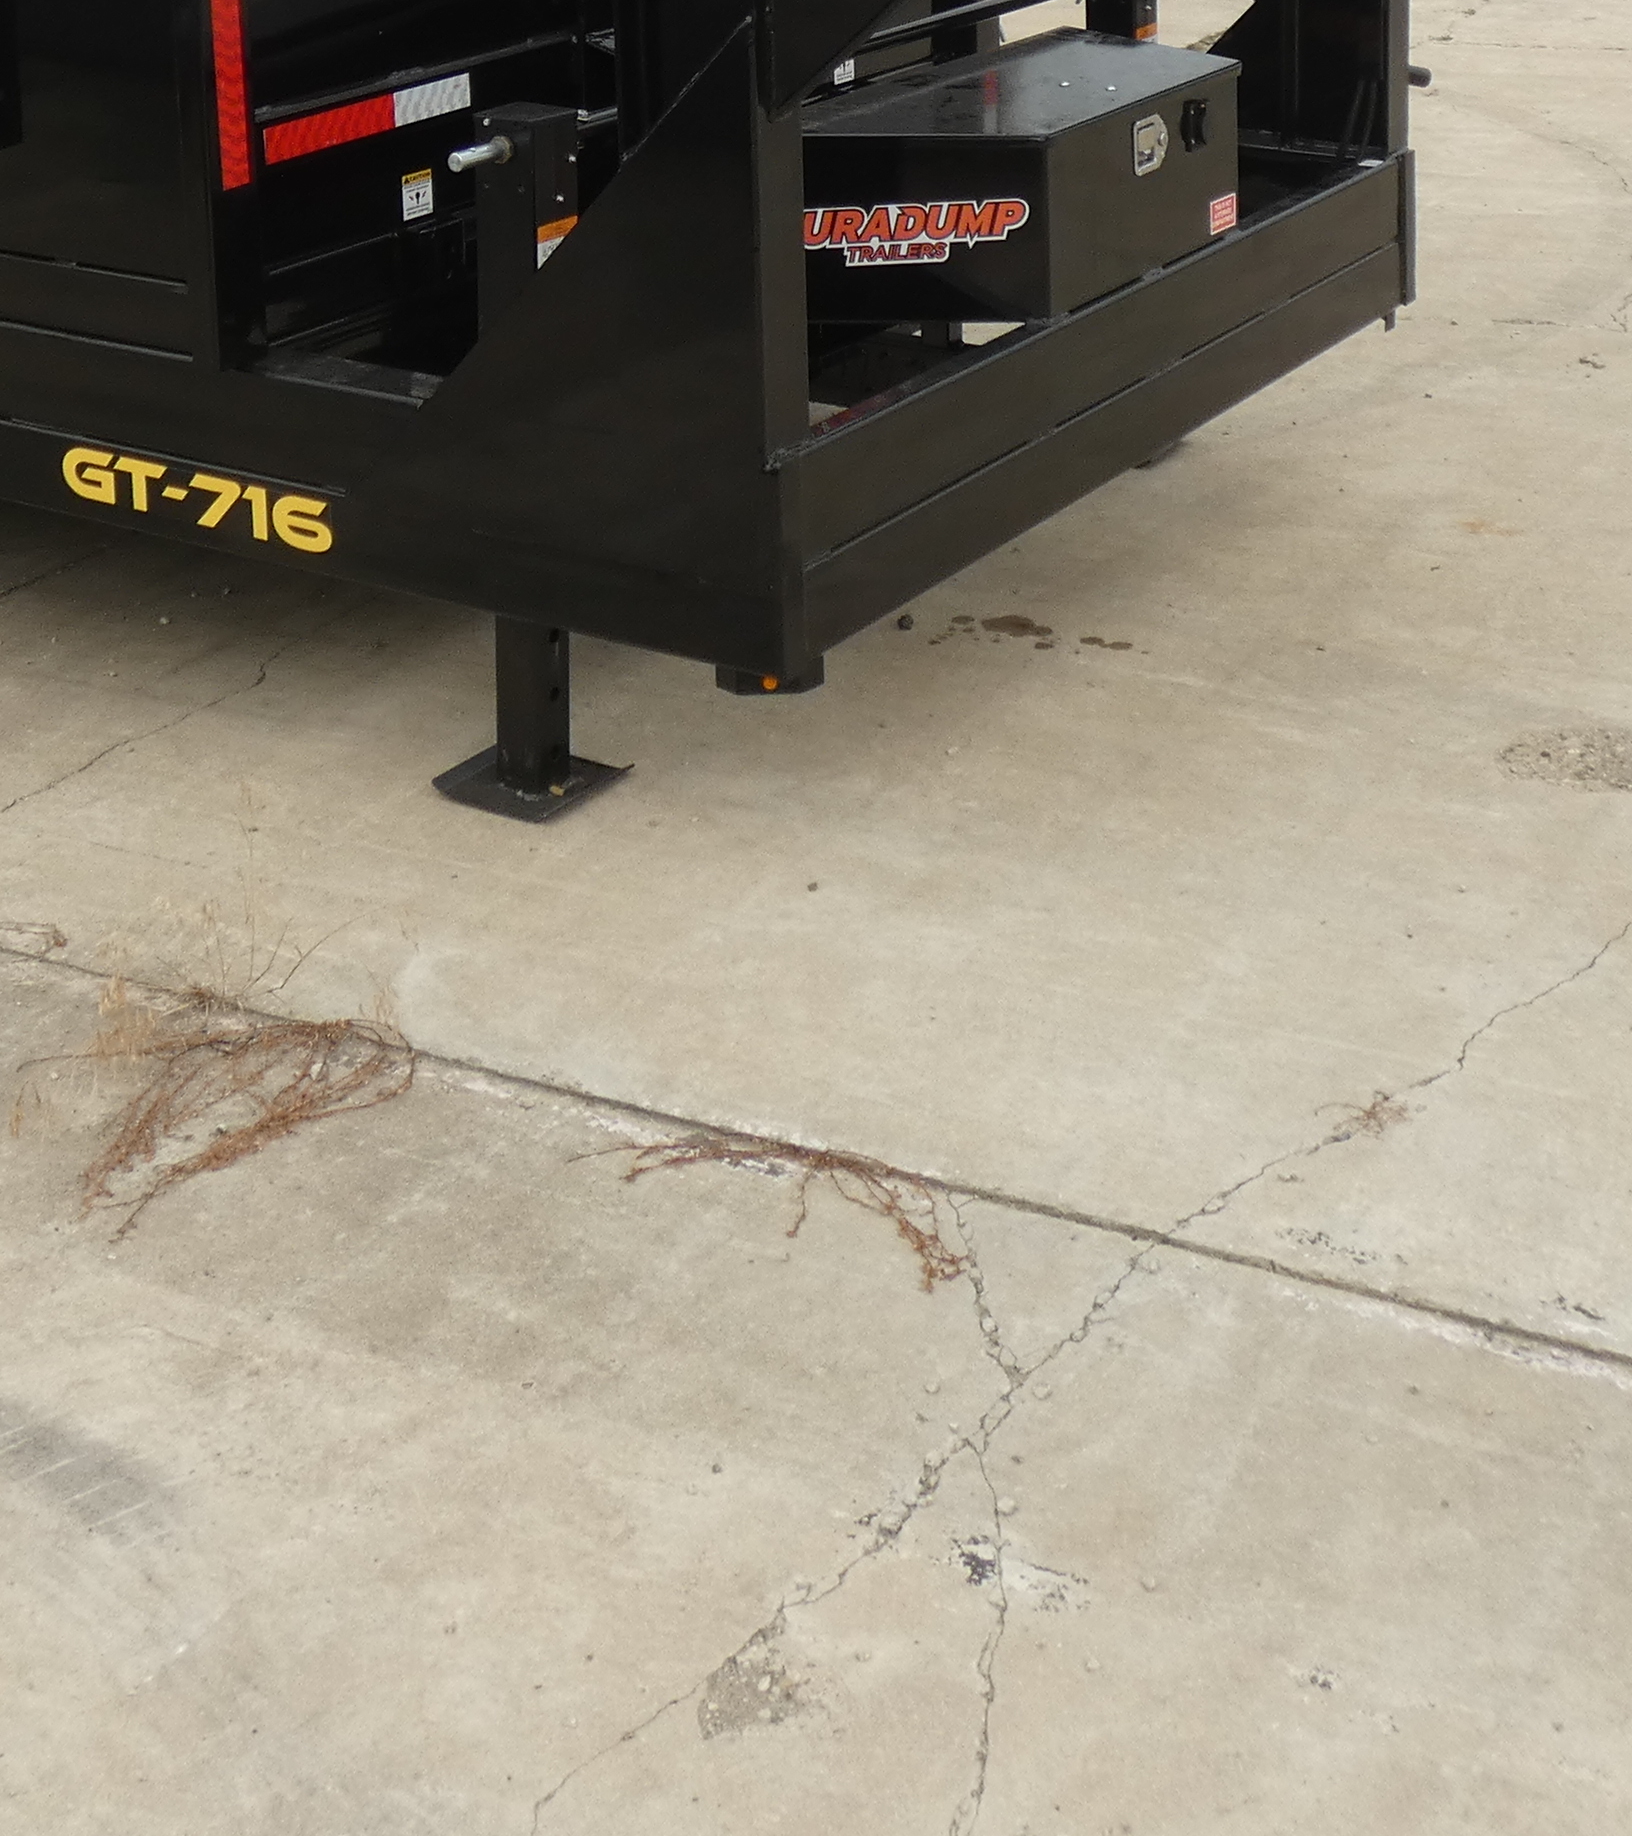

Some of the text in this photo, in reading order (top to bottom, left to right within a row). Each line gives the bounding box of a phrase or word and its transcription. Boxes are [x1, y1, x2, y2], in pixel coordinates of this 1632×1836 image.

[803, 200, 1028, 246] URADUMP
[847, 242, 948, 264] TRAILERS
[62, 447, 333, 553] GT-716
